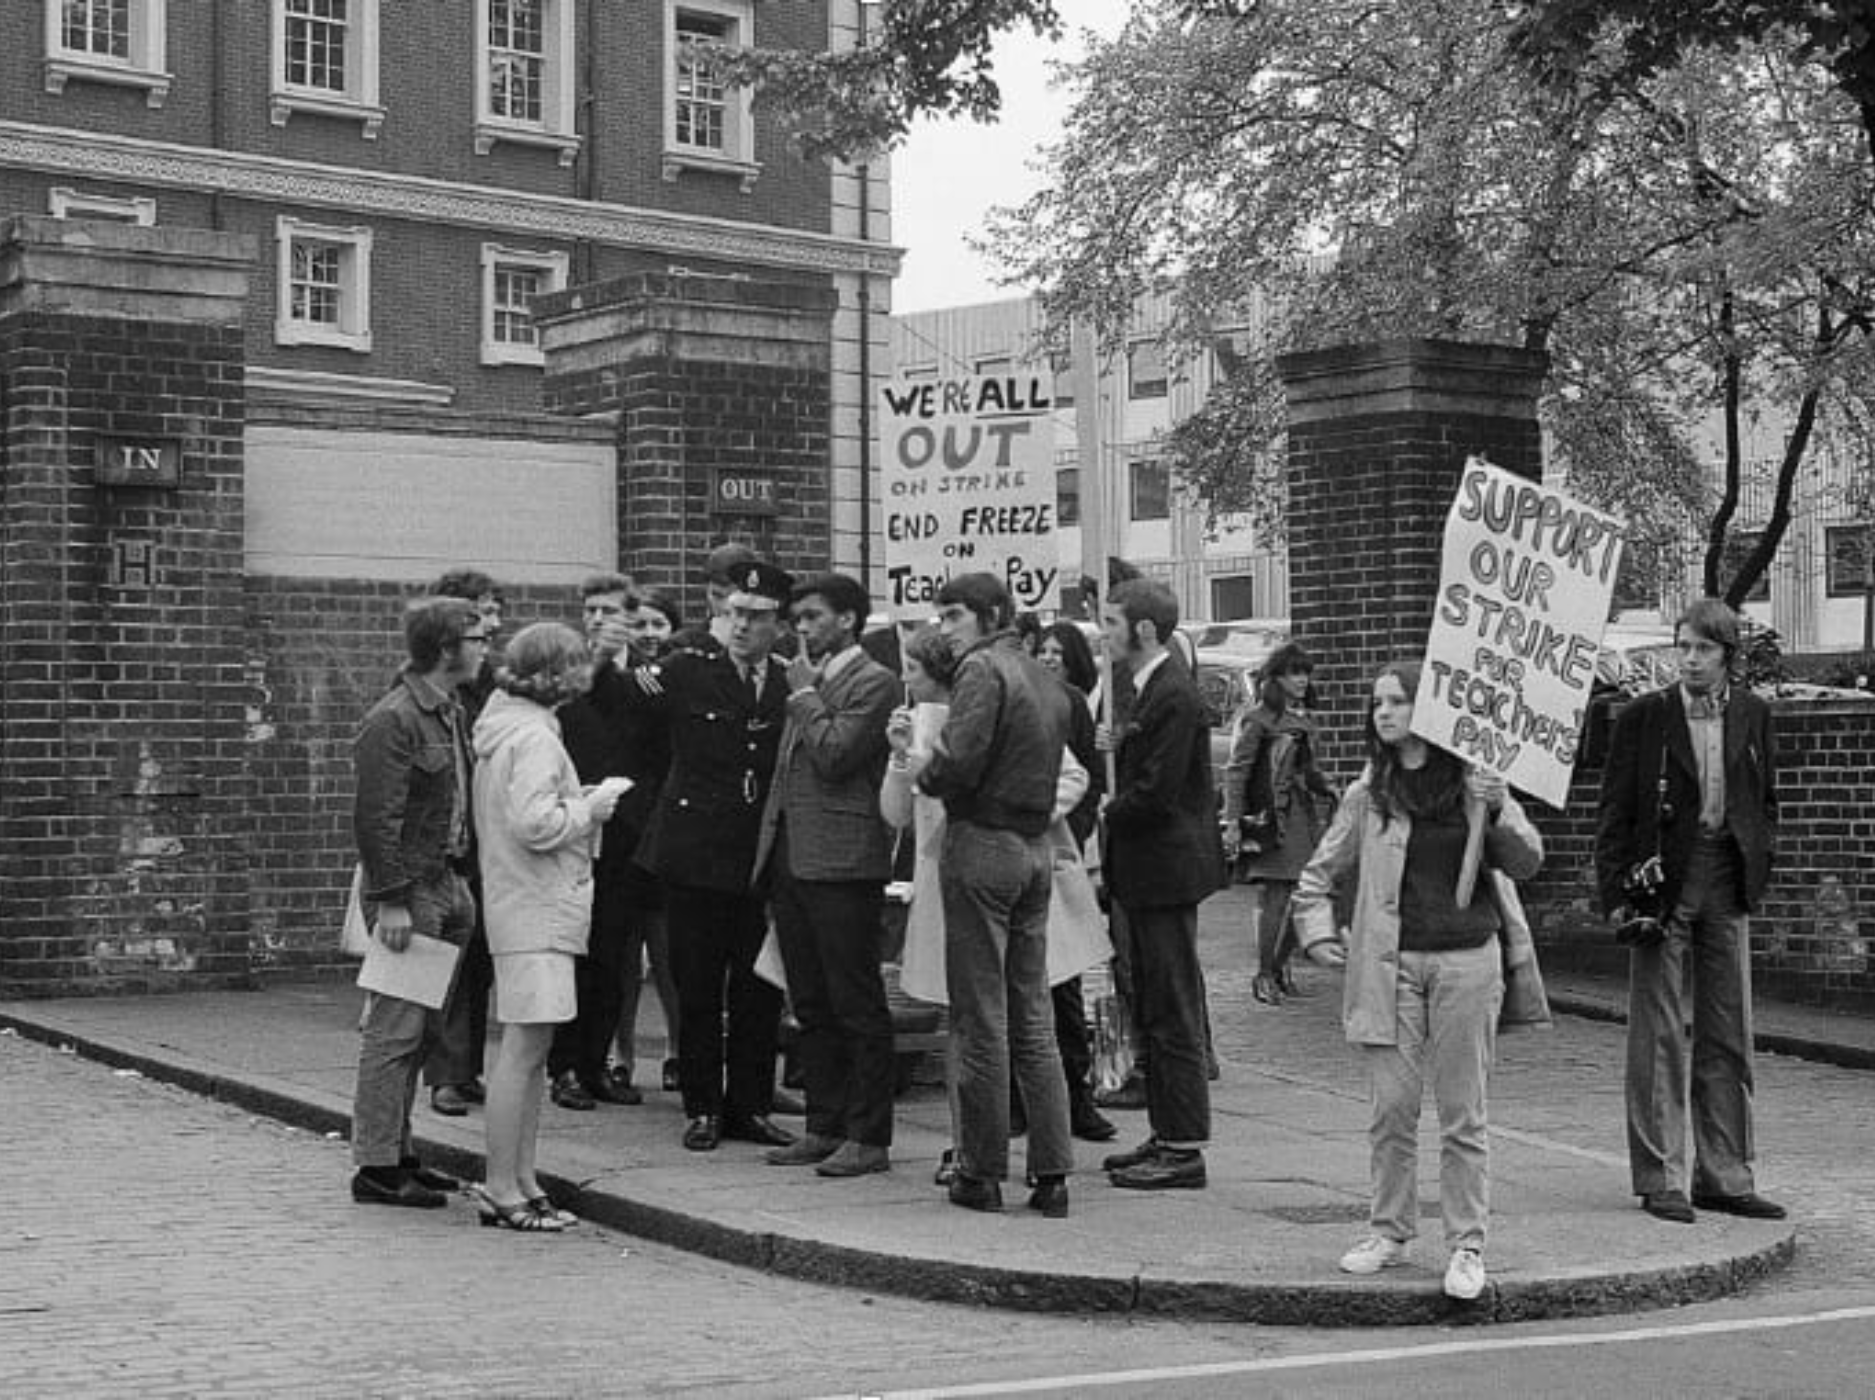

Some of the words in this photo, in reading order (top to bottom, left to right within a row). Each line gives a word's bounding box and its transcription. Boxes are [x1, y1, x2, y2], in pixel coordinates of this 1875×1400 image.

[882, 380, 972, 418] WE'RE
[976, 377, 1050, 411] ALL
[121, 446, 162, 469] IN
[897, 421, 1031, 471] OUT
[721, 479, 773, 499] OUT
[891, 479, 927, 497] ON
[938, 471, 1026, 493] STRIKE
[888, 513, 938, 540] END
[960, 504, 1052, 535] FREEZE
[1459, 470, 1624, 584] SUPPORT
[119, 543, 151, 585] H
[943, 542, 975, 558] ON
[1006, 556, 1057, 606] Pay
[1470, 540, 1555, 612] OUR
[1441, 583, 1598, 689] STRIKE
[1475, 647, 1525, 692] FOR
[1452, 716, 1520, 771] PAY
